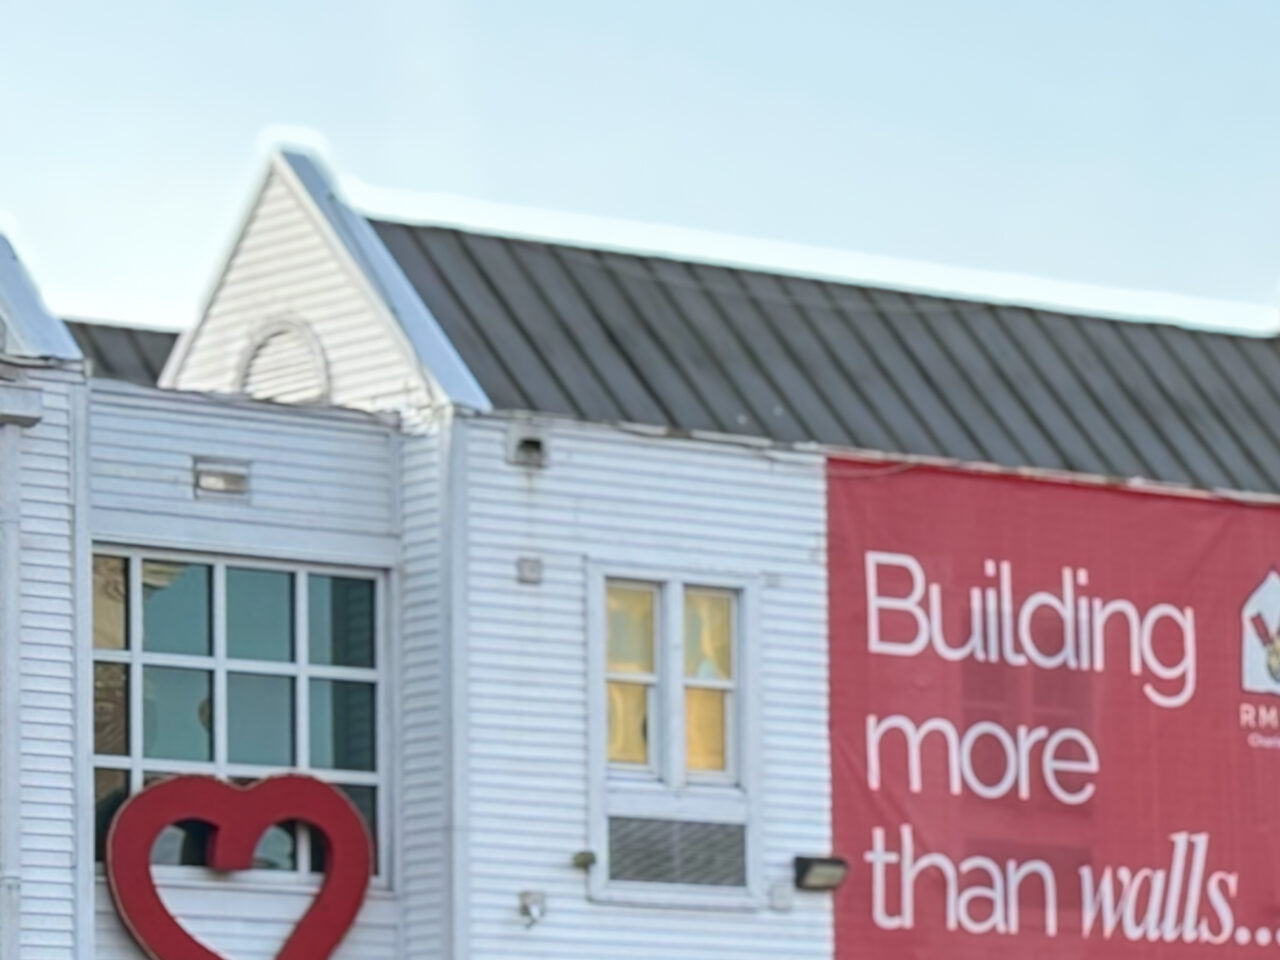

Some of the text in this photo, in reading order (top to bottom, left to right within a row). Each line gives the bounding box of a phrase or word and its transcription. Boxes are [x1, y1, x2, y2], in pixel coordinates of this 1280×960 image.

[864, 550, 1197, 707] Building
[866, 714, 1099, 804] more
[864, 824, 1057, 937] than
